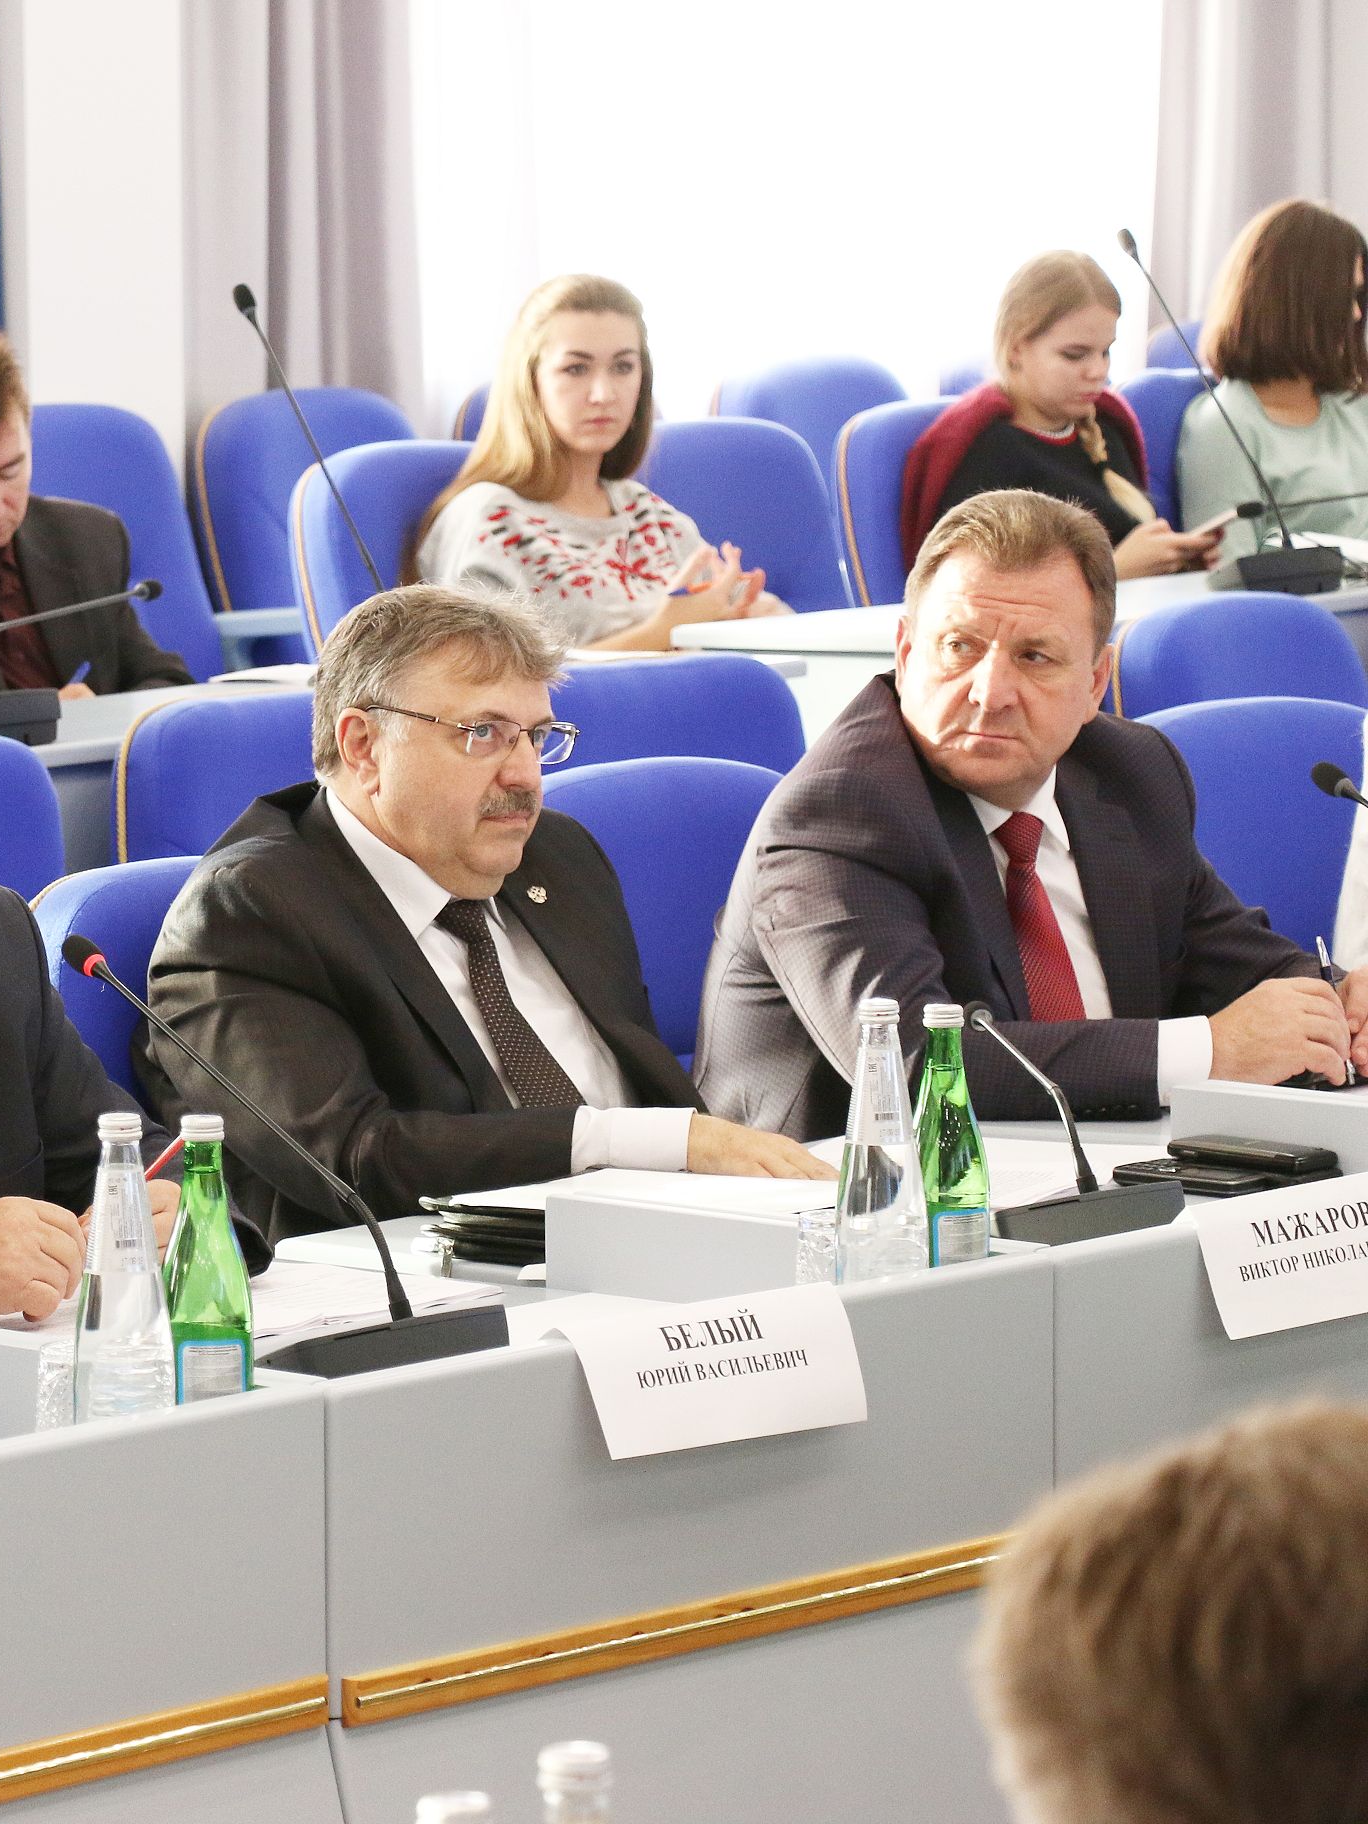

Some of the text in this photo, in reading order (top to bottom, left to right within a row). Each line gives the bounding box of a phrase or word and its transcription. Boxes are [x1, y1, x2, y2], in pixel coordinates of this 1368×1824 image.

[1239, 1241, 1368, 1282] ВИКТОР НИКОЛА
[659, 1309, 764, 1352] БЕЛЫЙ
[636, 1349, 809, 1389] ЮРИЙ ВАСИЛЬЕВИЧ
